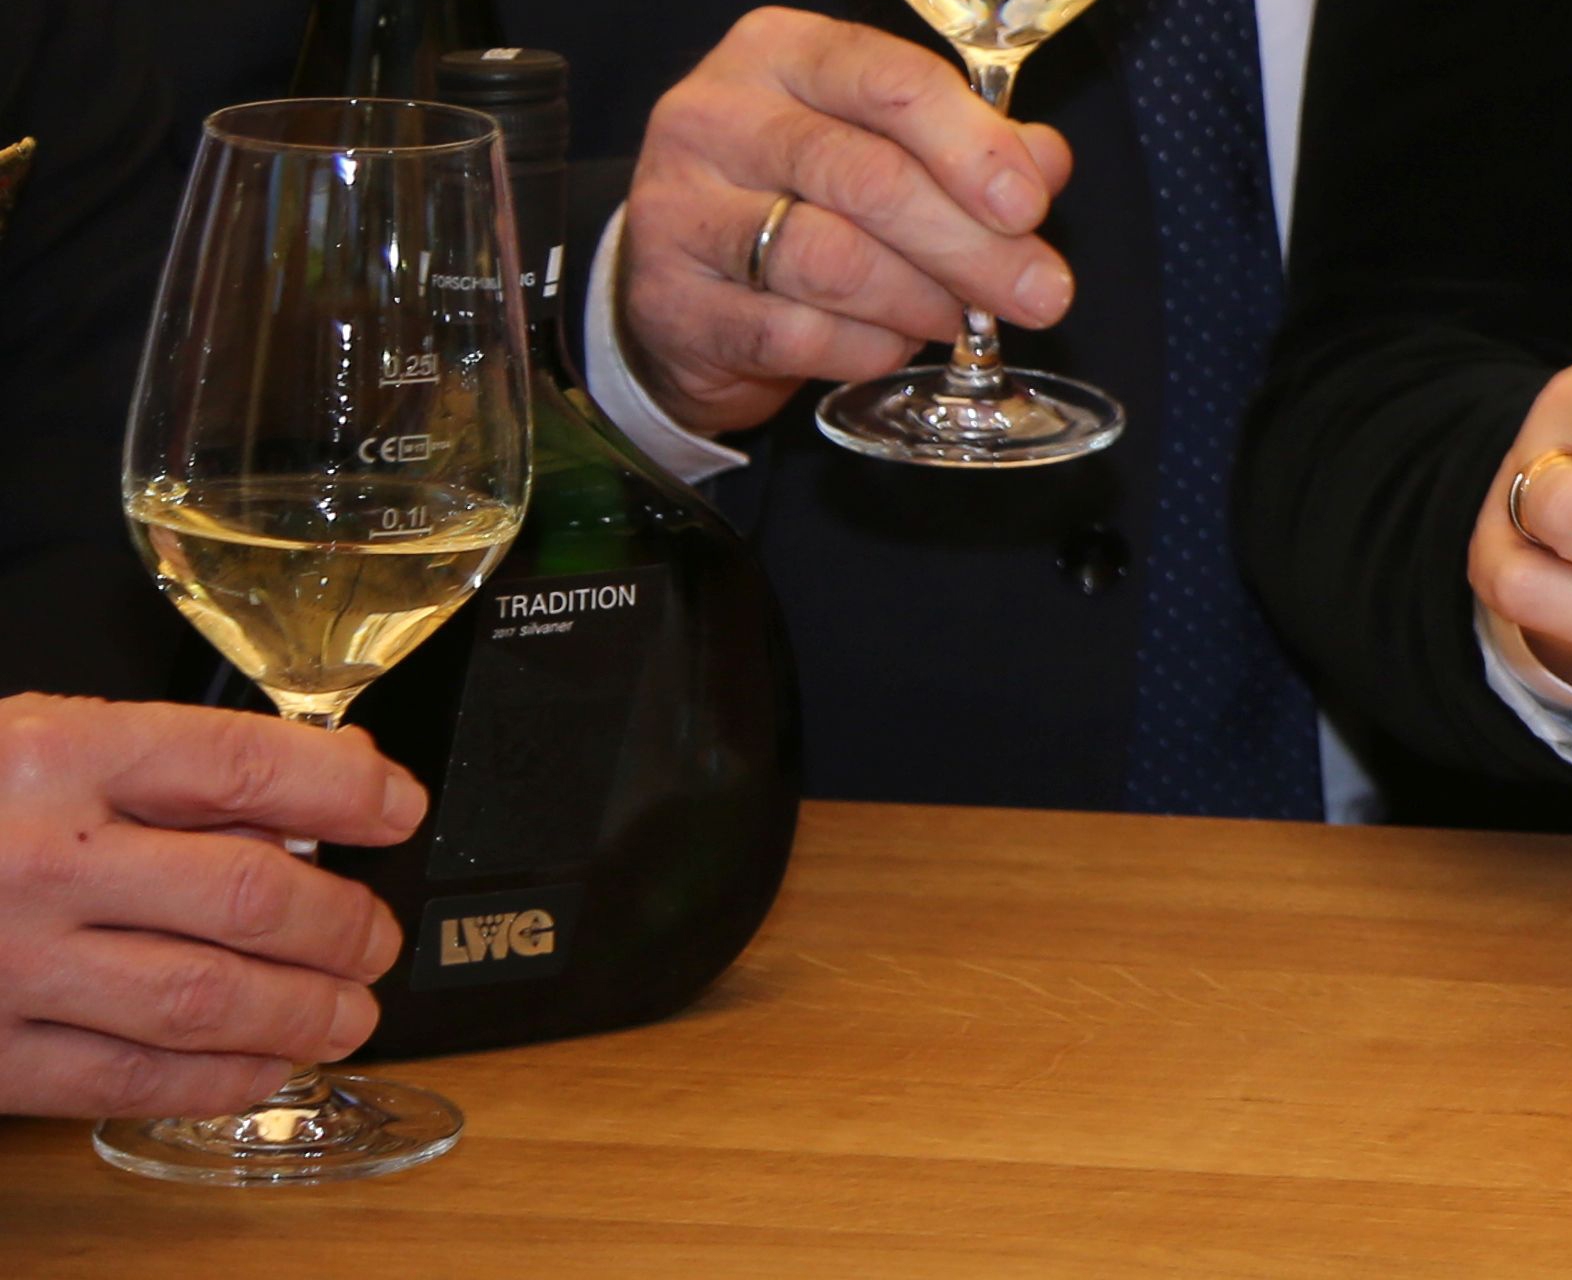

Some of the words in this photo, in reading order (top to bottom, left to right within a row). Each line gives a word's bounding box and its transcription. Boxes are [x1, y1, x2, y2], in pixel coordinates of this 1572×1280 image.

[495, 583, 636, 619] TRADITION
[519, 620, 575, 637] silvaner
[440, 908, 555, 967] LWG
